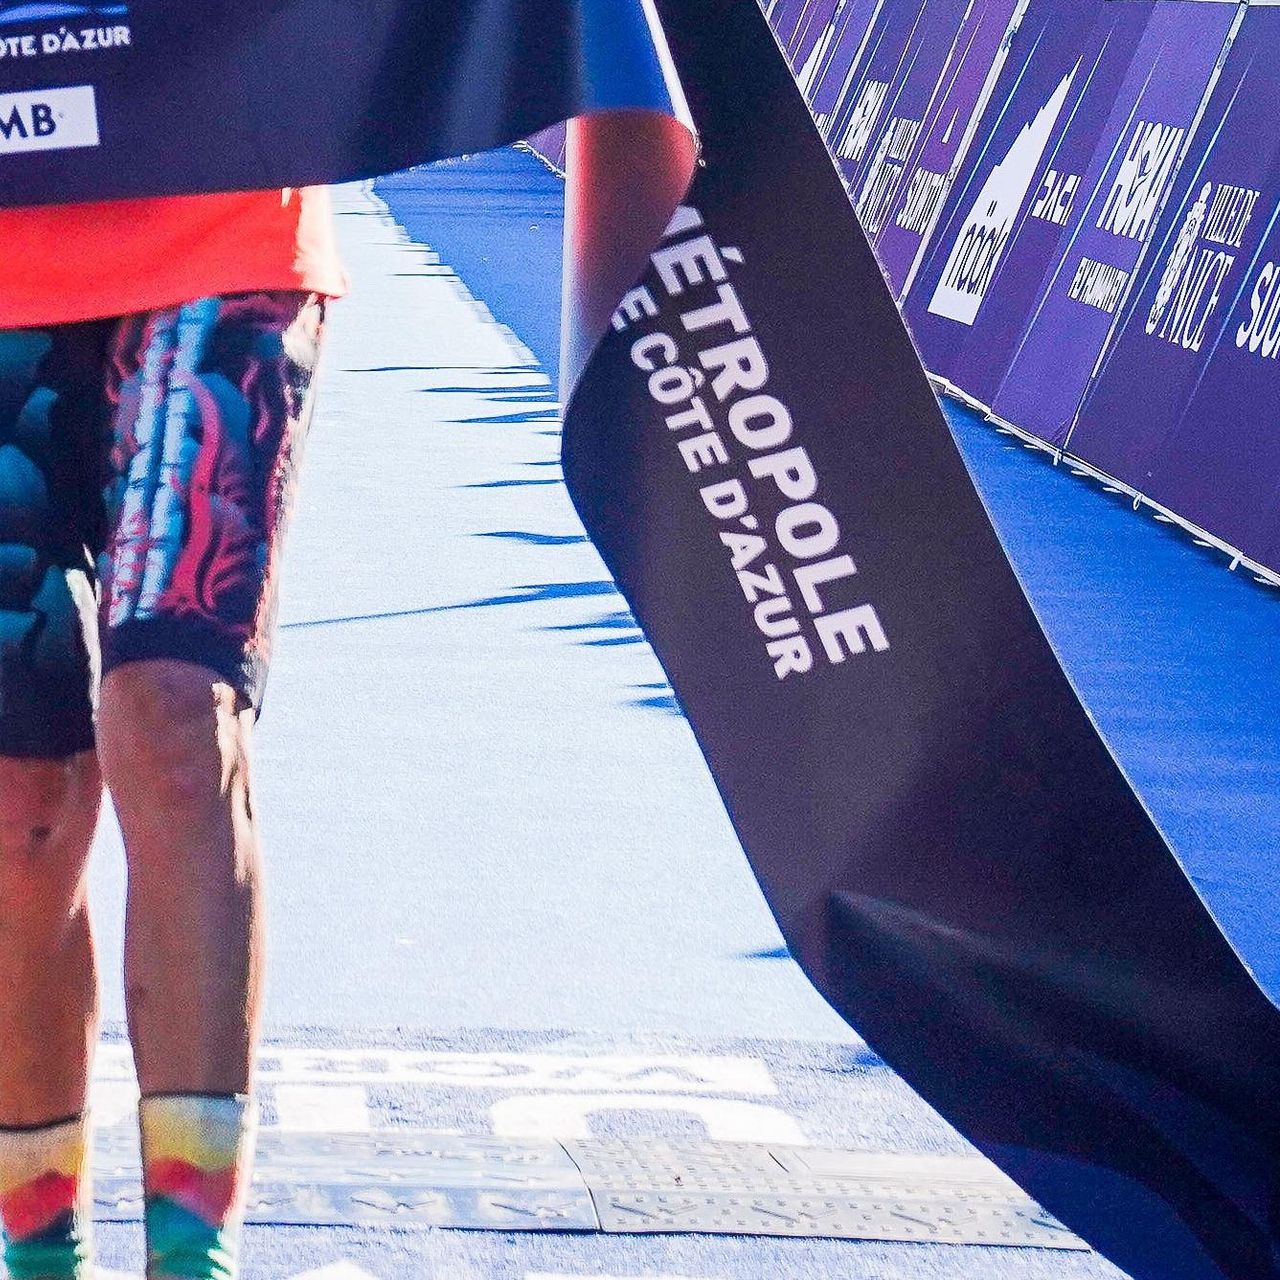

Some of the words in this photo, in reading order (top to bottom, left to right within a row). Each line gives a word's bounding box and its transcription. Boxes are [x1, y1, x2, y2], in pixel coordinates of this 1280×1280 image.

[42, 24, 133, 56] D'AZUR
[895, 167, 949, 236] SUUNTO
[1095, 120, 1185, 243] HOKA
[610, 284, 659, 334] E
[1158, 245, 1235, 353] NICE
[631, 331, 731, 474] CÔTE
[698, 477, 815, 681] D'AZUR
